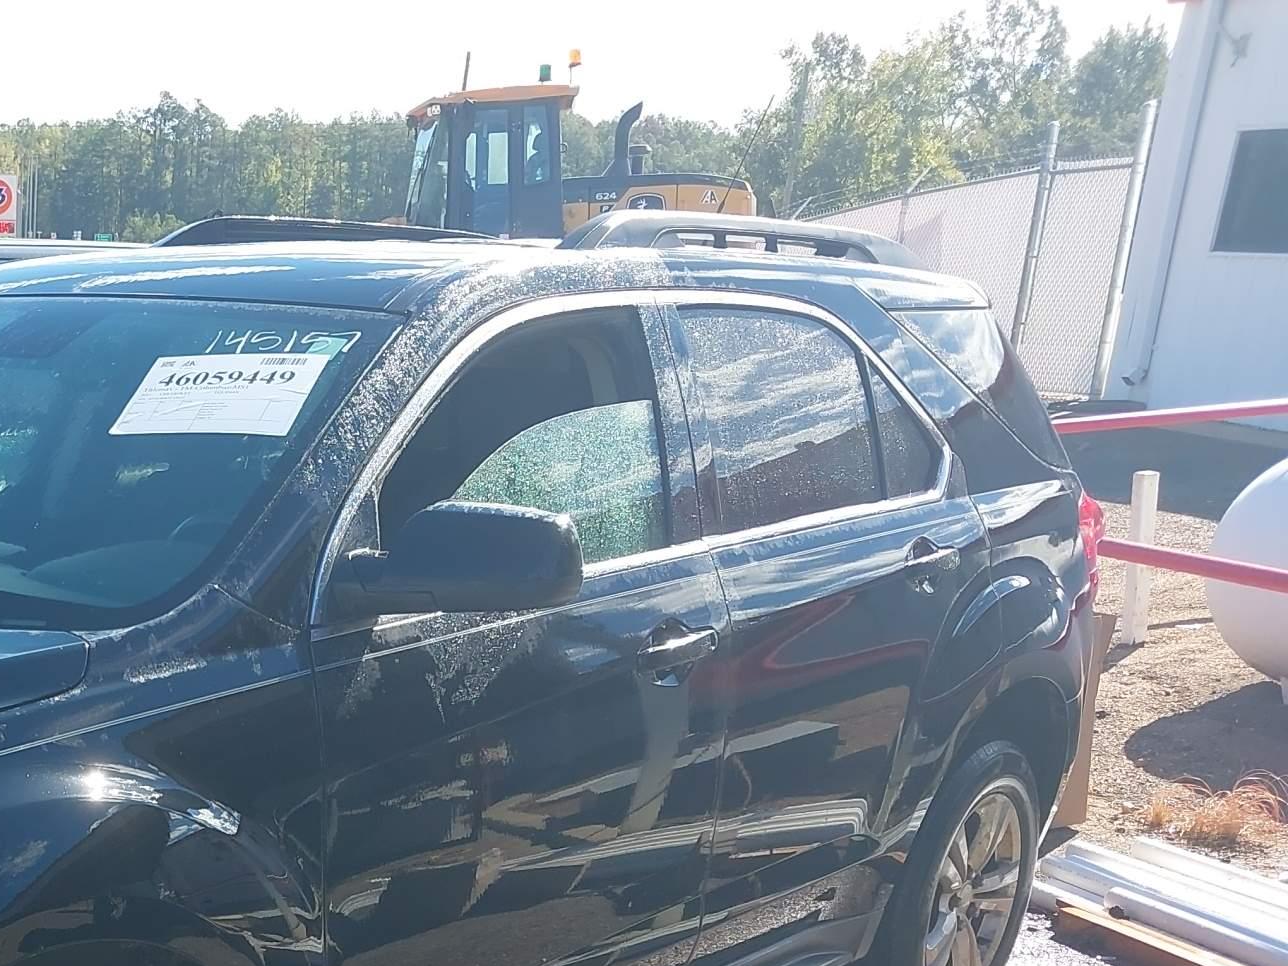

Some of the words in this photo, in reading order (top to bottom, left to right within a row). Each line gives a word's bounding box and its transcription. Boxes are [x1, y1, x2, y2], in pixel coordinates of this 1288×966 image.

[595, 191, 617, 201] 624
[204, 330, 362, 354] 145157
[158, 369, 296, 387] 46059449
